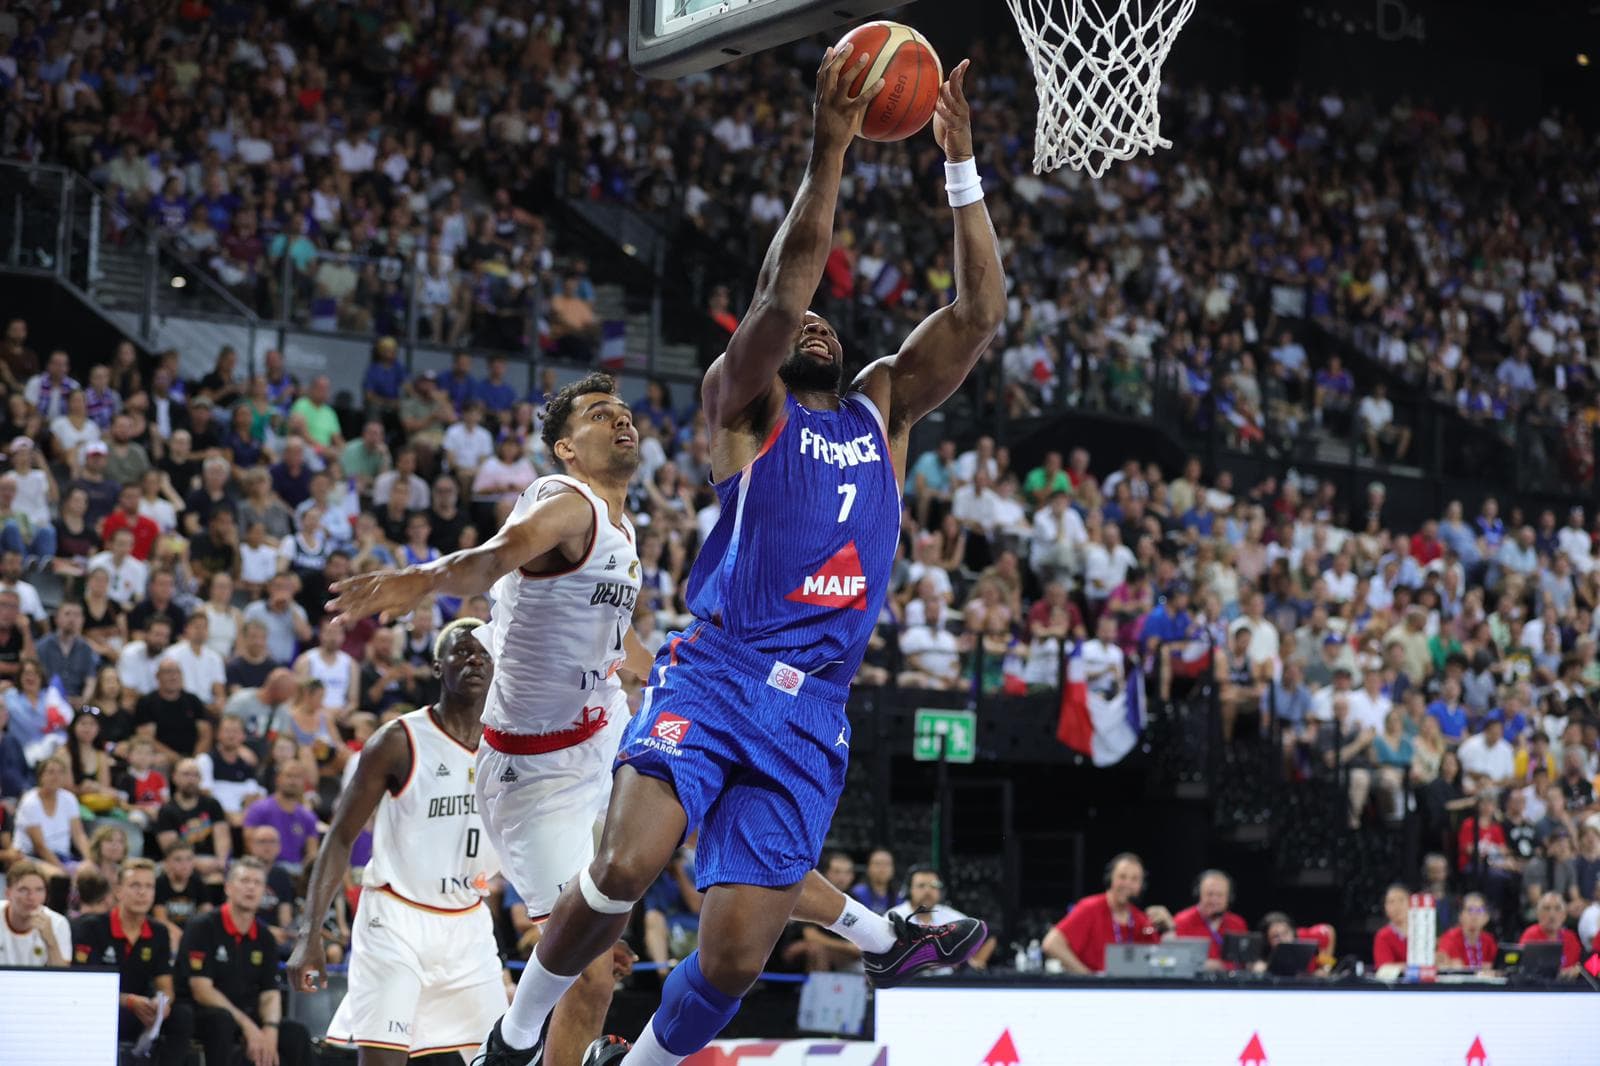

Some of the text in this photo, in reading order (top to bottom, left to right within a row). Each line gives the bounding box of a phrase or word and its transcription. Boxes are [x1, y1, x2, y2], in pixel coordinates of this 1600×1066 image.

[880, 75, 908, 124] molten
[800, 427, 881, 469] FRANCE
[837, 483, 857, 523] 7
[802, 575, 867, 597] MAIF
